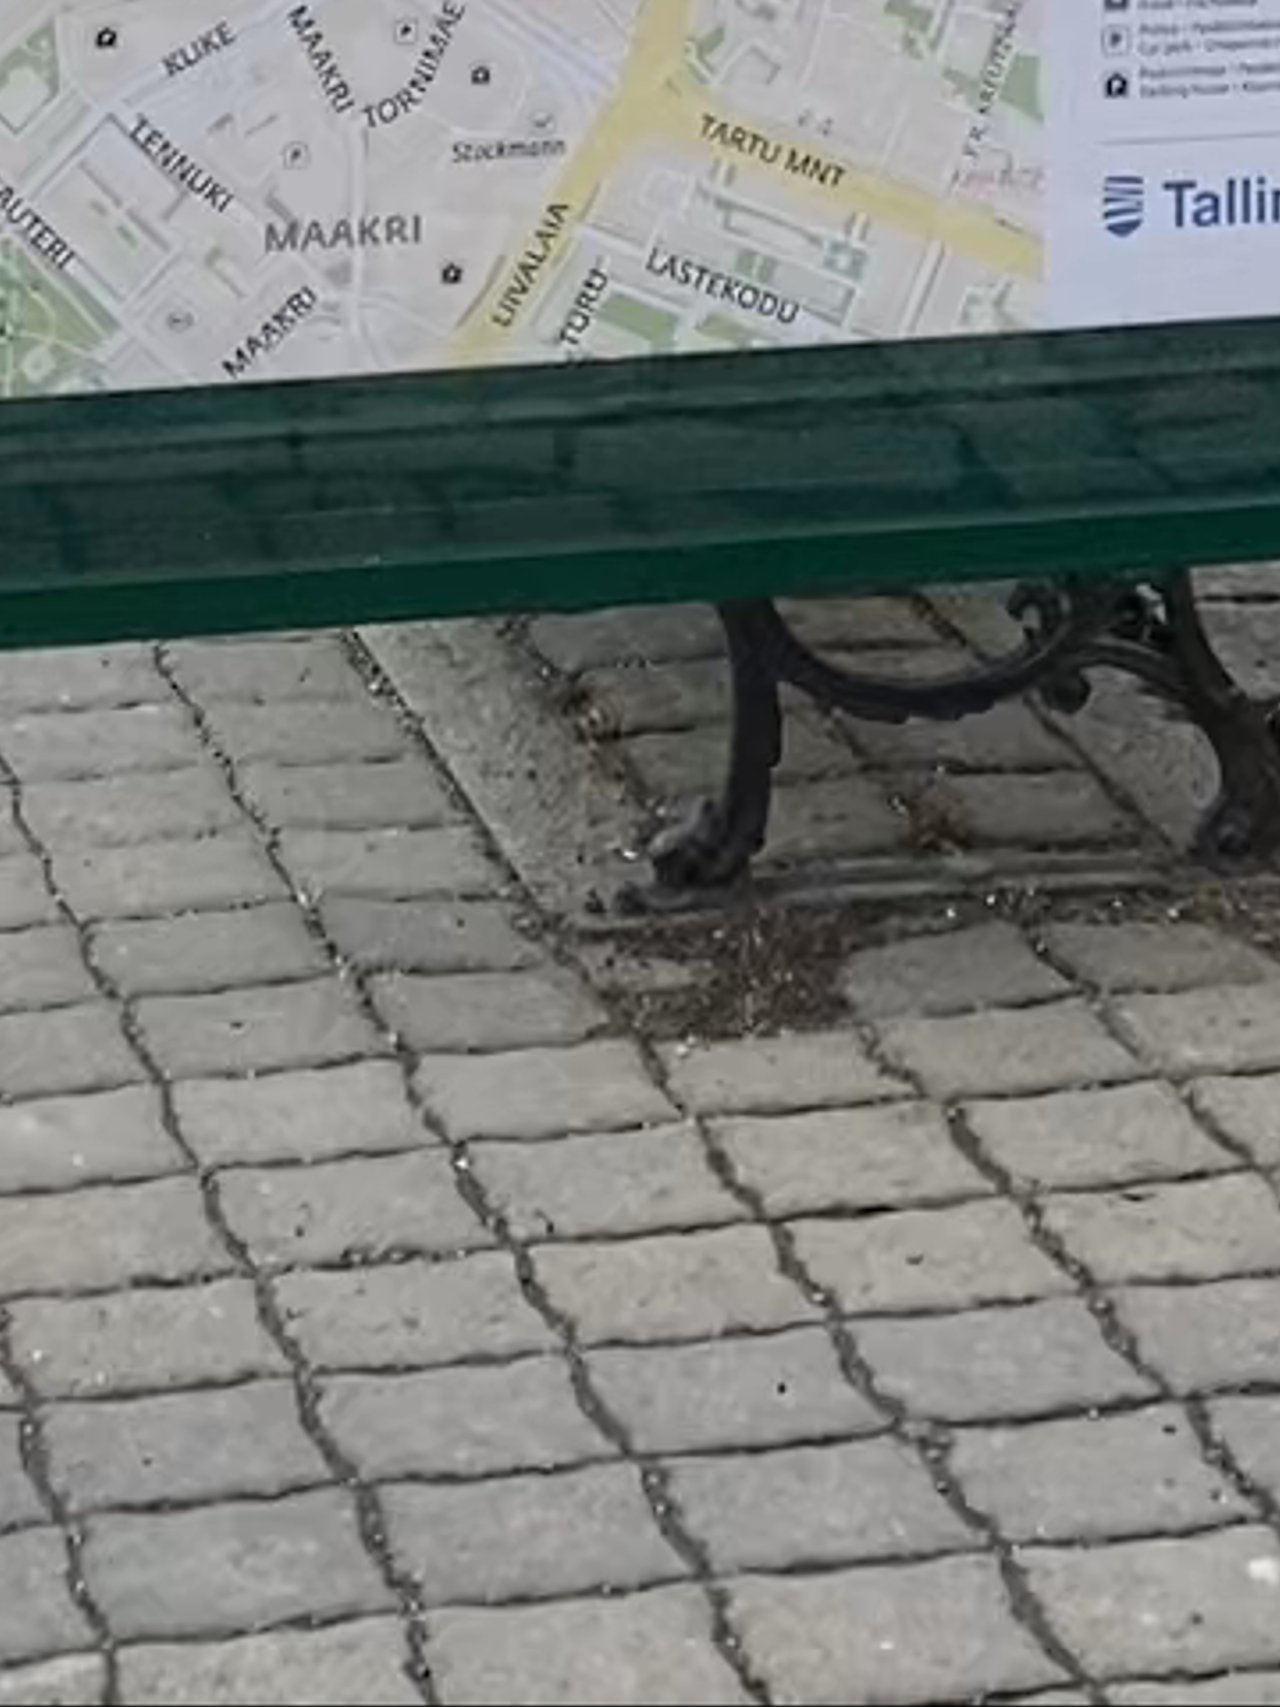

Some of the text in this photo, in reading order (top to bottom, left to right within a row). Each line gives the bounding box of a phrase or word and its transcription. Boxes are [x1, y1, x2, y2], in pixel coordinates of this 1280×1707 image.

[161, 19, 238, 79] KUKE
[288, 3, 356, 114] MAAKRI
[128, 112, 237, 214] LENNUKI
[451, 137, 567, 163] Stockmann
[699, 112, 847, 188] TARTU MNT
[264, 214, 422, 252] MAAKRI
[490, 201, 572, 329] LIIVALAIA
[643, 245, 800, 324] LASTEKODU
[220, 284, 320, 379] MAAKRI
